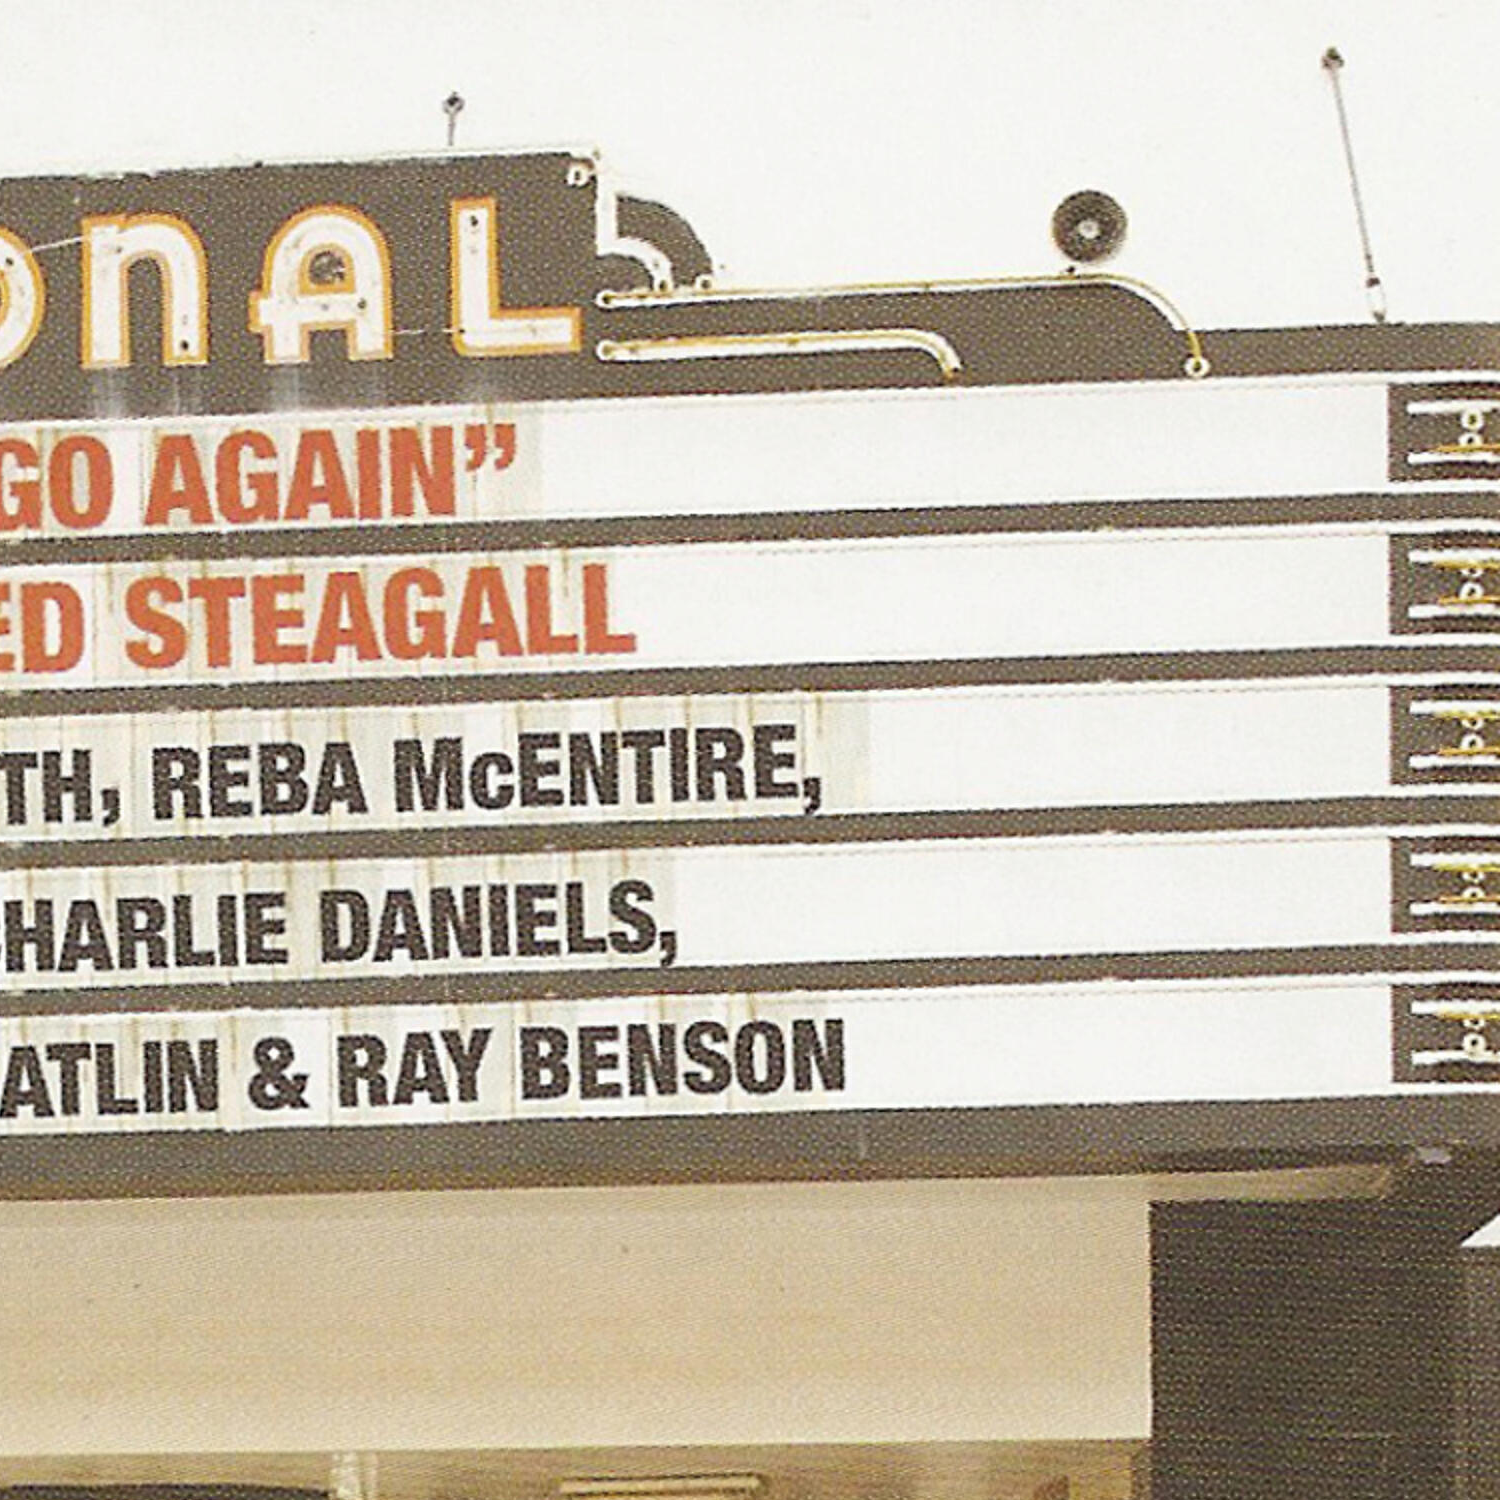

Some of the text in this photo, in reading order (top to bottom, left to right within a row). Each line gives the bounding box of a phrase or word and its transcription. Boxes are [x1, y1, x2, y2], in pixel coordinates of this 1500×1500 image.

[126, 563, 635, 669] STEAGALL
[152, 741, 368, 820] REBA
[393, 724, 823, 814] McENTIRE,
[319, 880, 679, 968] DANIELS,
[248, 1037, 309, 1111] &
[337, 1028, 492, 1108] RAY
[519, 1018, 845, 1100] BENSON
